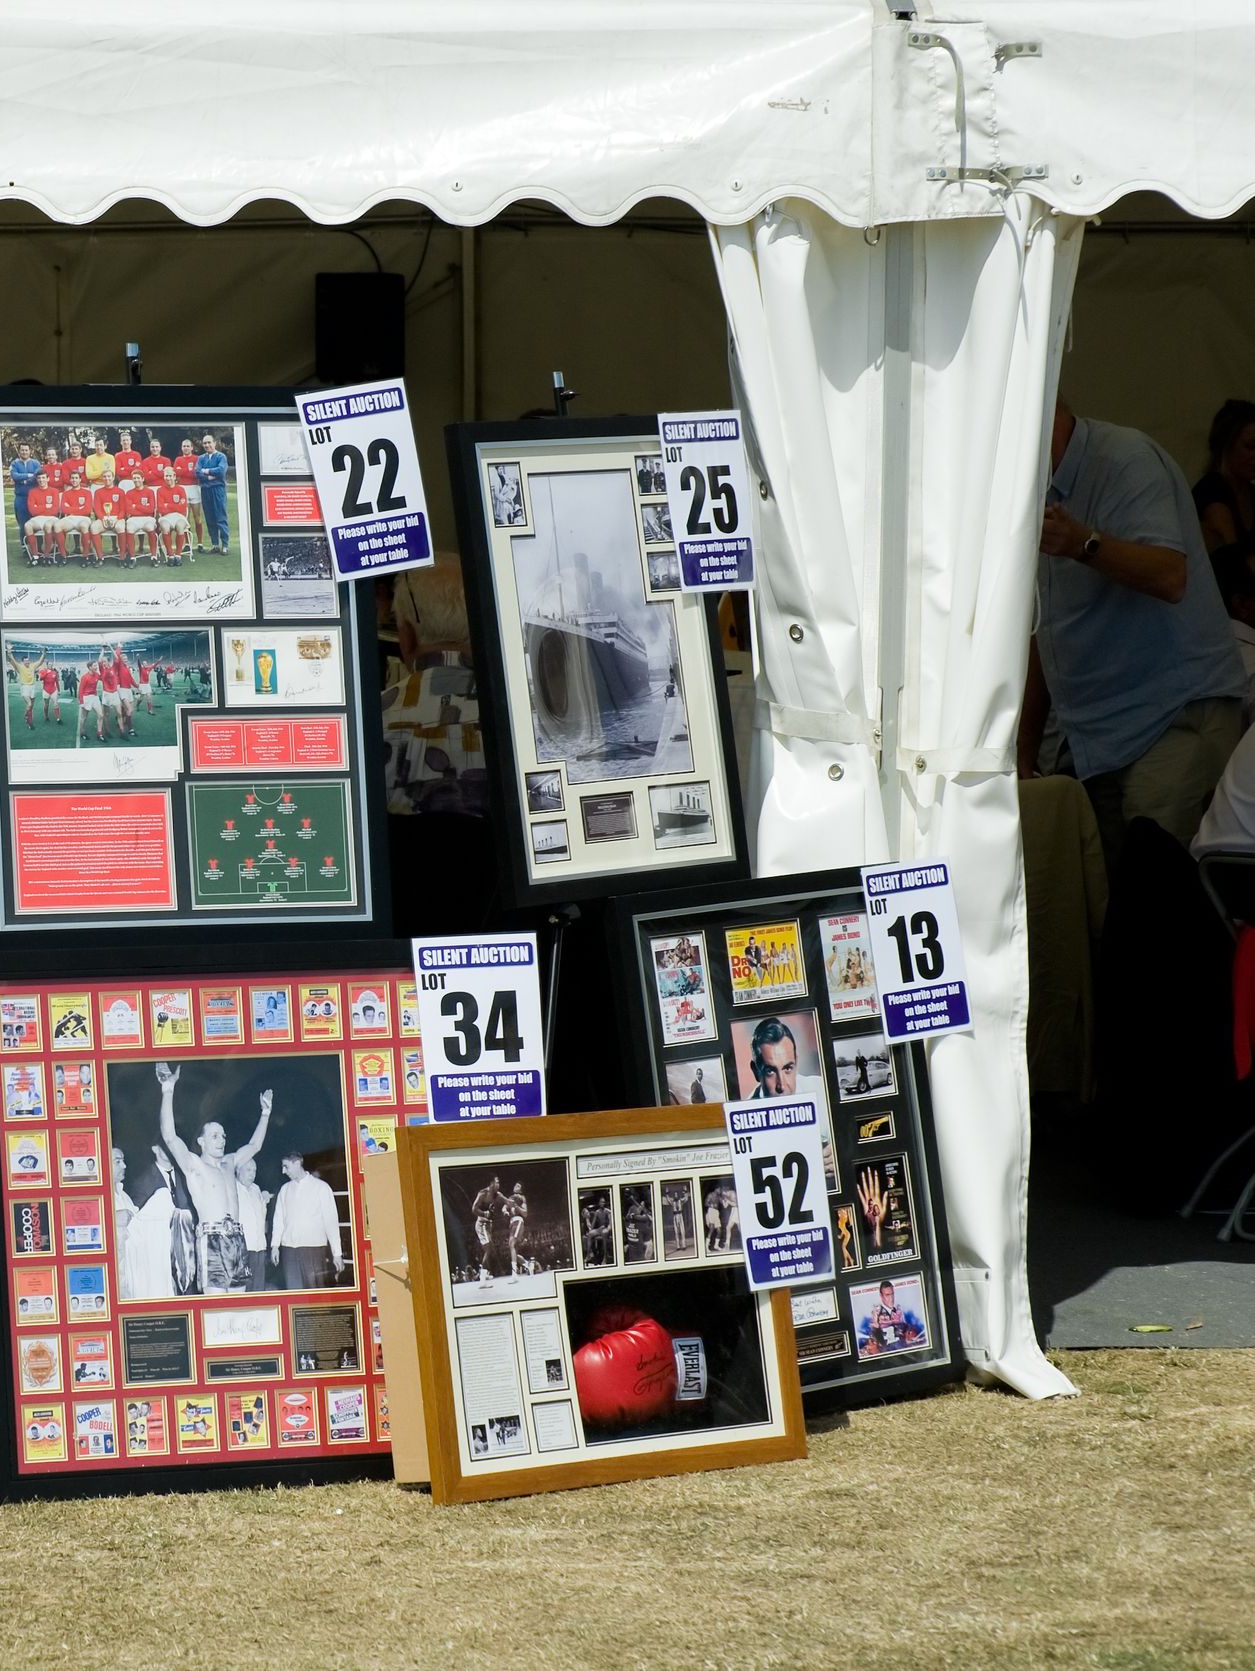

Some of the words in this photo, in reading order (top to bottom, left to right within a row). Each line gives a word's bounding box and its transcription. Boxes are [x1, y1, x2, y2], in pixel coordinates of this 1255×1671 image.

[307, 400, 348, 421] SILENT
[351, 391, 400, 414] AUCTION
[309, 426, 332, 445] LOT
[665, 424, 695, 440] SILENT
[697, 422, 736, 438] AUCTION
[665, 447, 682, 463] LOT
[332, 438, 407, 518] 22
[680, 465, 738, 535] 25
[338, 525, 365, 540] Please
[367, 522, 387, 534] write
[388, 518, 408, 532] your
[407, 515, 418, 528] bid
[358, 541, 369, 551] on
[369, 538, 383, 549] the
[384, 533, 406, 546] sheet
[361, 556, 369, 566] at
[370, 553, 388, 565] your
[389, 548, 408, 560] table
[869, 874, 900, 893] SILENT
[902, 867, 945, 888] AUCTION
[870, 899, 887, 916] LOT
[423, 949, 468, 966] SILENT
[471, 946, 529, 964] AUCTION
[887, 911, 944, 983] 13
[732, 966, 751, 978] NO
[421, 973, 446, 990] LOT
[441, 990, 524, 1066] 34
[438, 1076, 469, 1088] Please
[471, 1075, 494, 1086] write
[496, 1075, 516, 1086] your
[518, 1073, 532, 1084] bid
[459, 1092, 471, 1102] on
[472, 1091, 488, 1101] the
[489, 1089, 515, 1100] sheet
[460, 1108, 469, 1117] at
[471, 1107, 491, 1117] your
[493, 1104, 516, 1115] table
[733, 1110, 767, 1130] SILENT
[769, 1105, 813, 1126] AUCTION
[734, 1137, 752, 1154] LOT
[587, 1159, 623, 1171] Personally
[624, 1158, 646, 1169] Signed
[648, 1156, 656, 1167] By
[692, 1152, 703, 1161] Joe
[705, 1151, 729, 1160] Frazier
[750, 1152, 814, 1229] 52
[868, 1248, 914, 1263] GOLDFINGER
[678, 1343, 702, 1393] EVERLAST
[77, 1407, 101, 1423] COOPER
